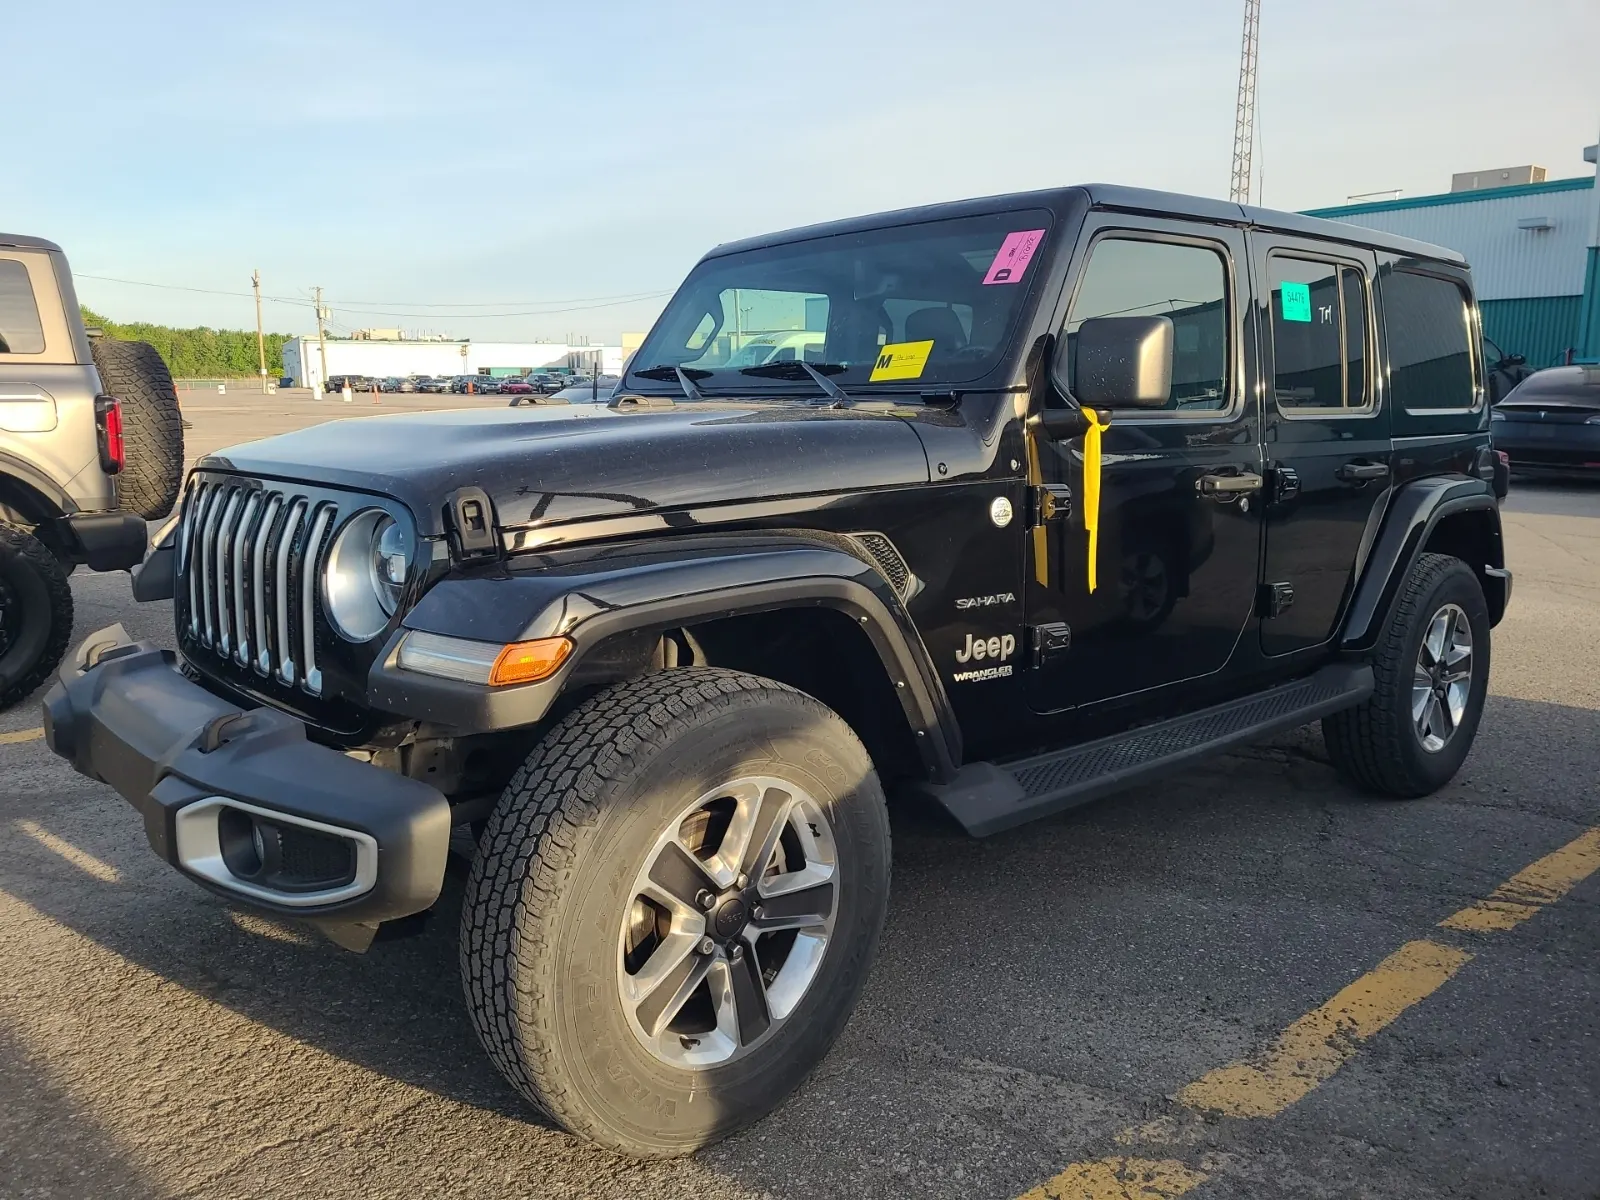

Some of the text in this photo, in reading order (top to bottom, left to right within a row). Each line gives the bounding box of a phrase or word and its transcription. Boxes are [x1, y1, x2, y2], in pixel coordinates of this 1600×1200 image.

[993, 268, 1012, 281] D
[876, 354, 893, 370] M
[955, 592, 1016, 609] SAHARA
[955, 633, 1016, 664] Jeep
[953, 665, 1012, 682] WRANGLER
